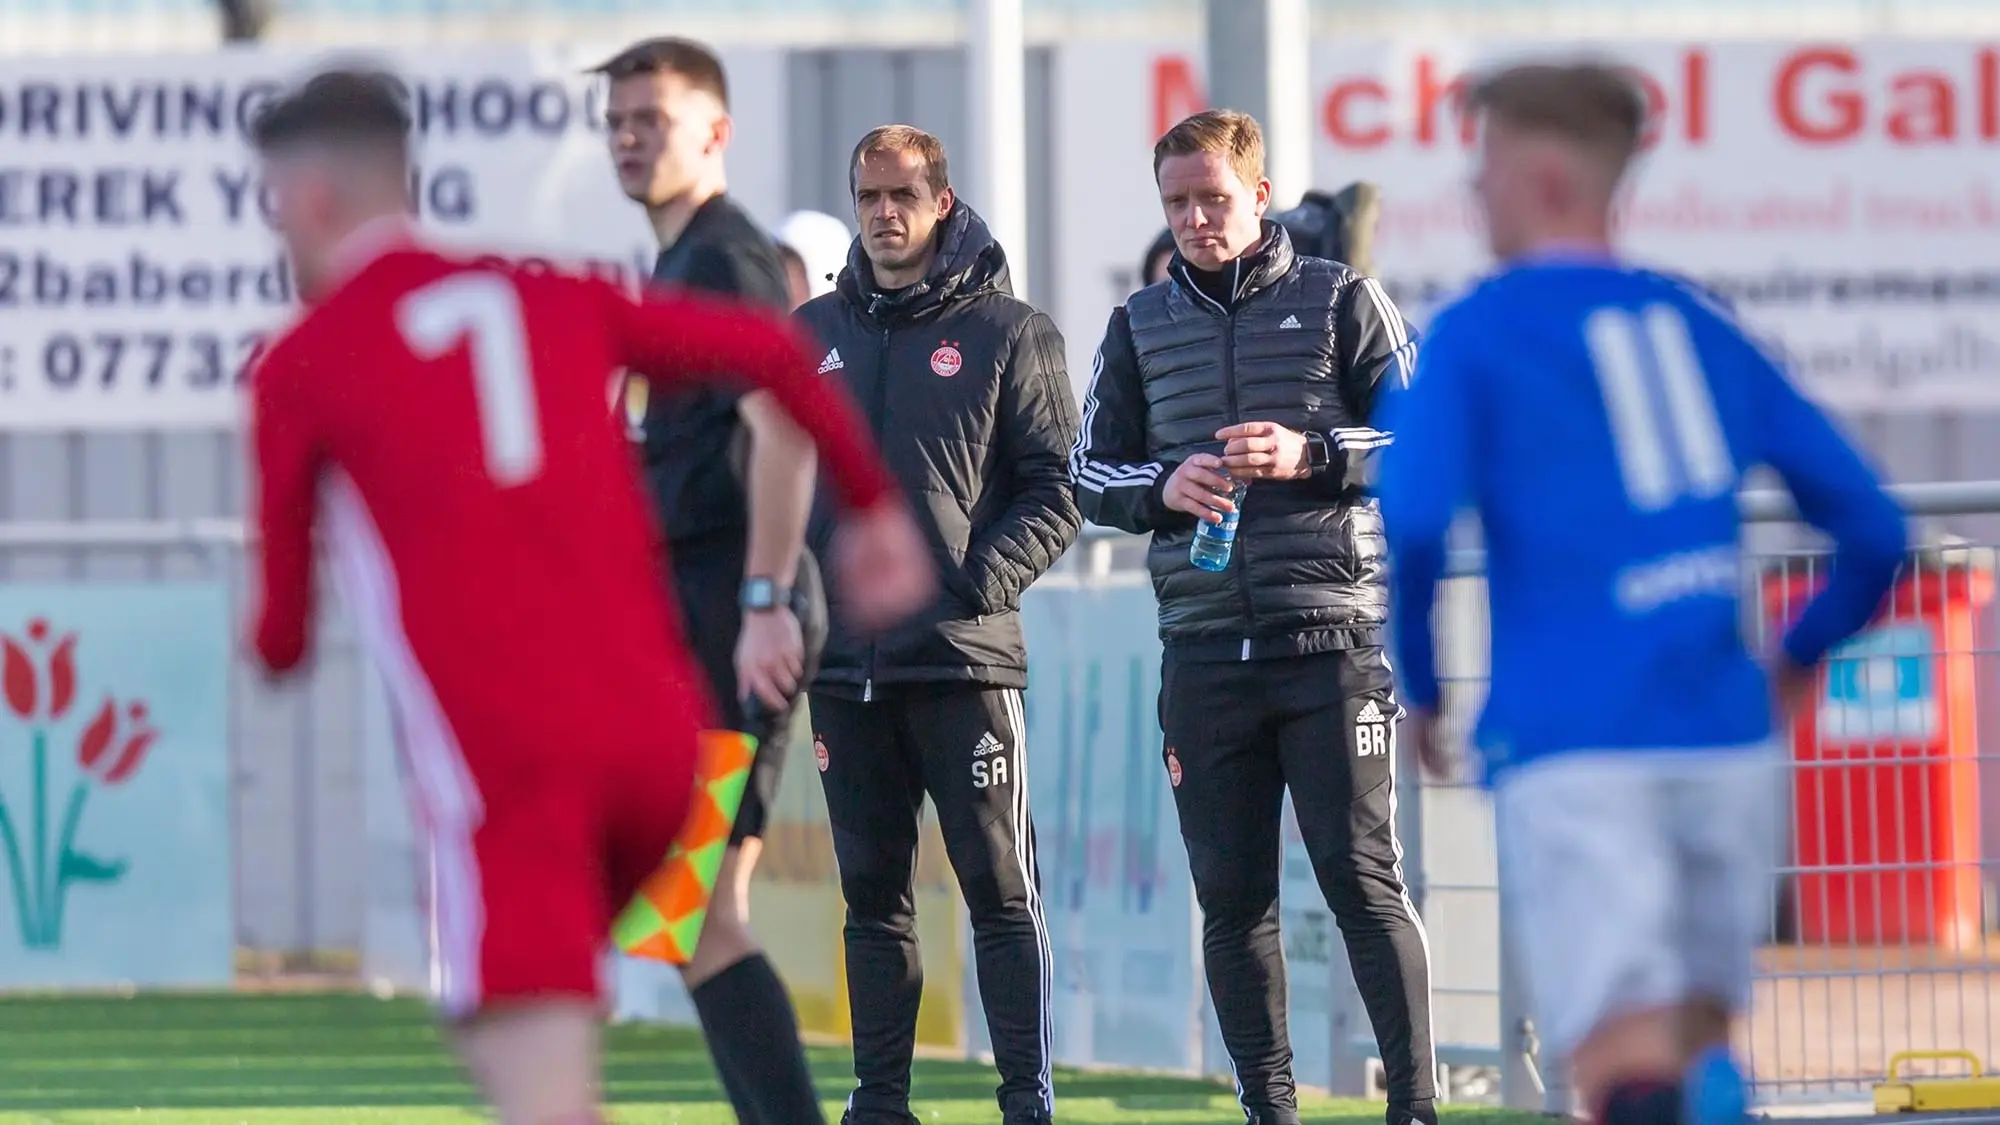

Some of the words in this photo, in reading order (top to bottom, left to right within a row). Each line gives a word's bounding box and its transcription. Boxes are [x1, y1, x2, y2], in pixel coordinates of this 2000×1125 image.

[817, 360, 845, 375] adidas
[1586, 303, 1733, 509] 11
[973, 743, 1005, 757] adidas
[1355, 723, 1386, 757] BR
[971, 756, 1008, 788] SA
